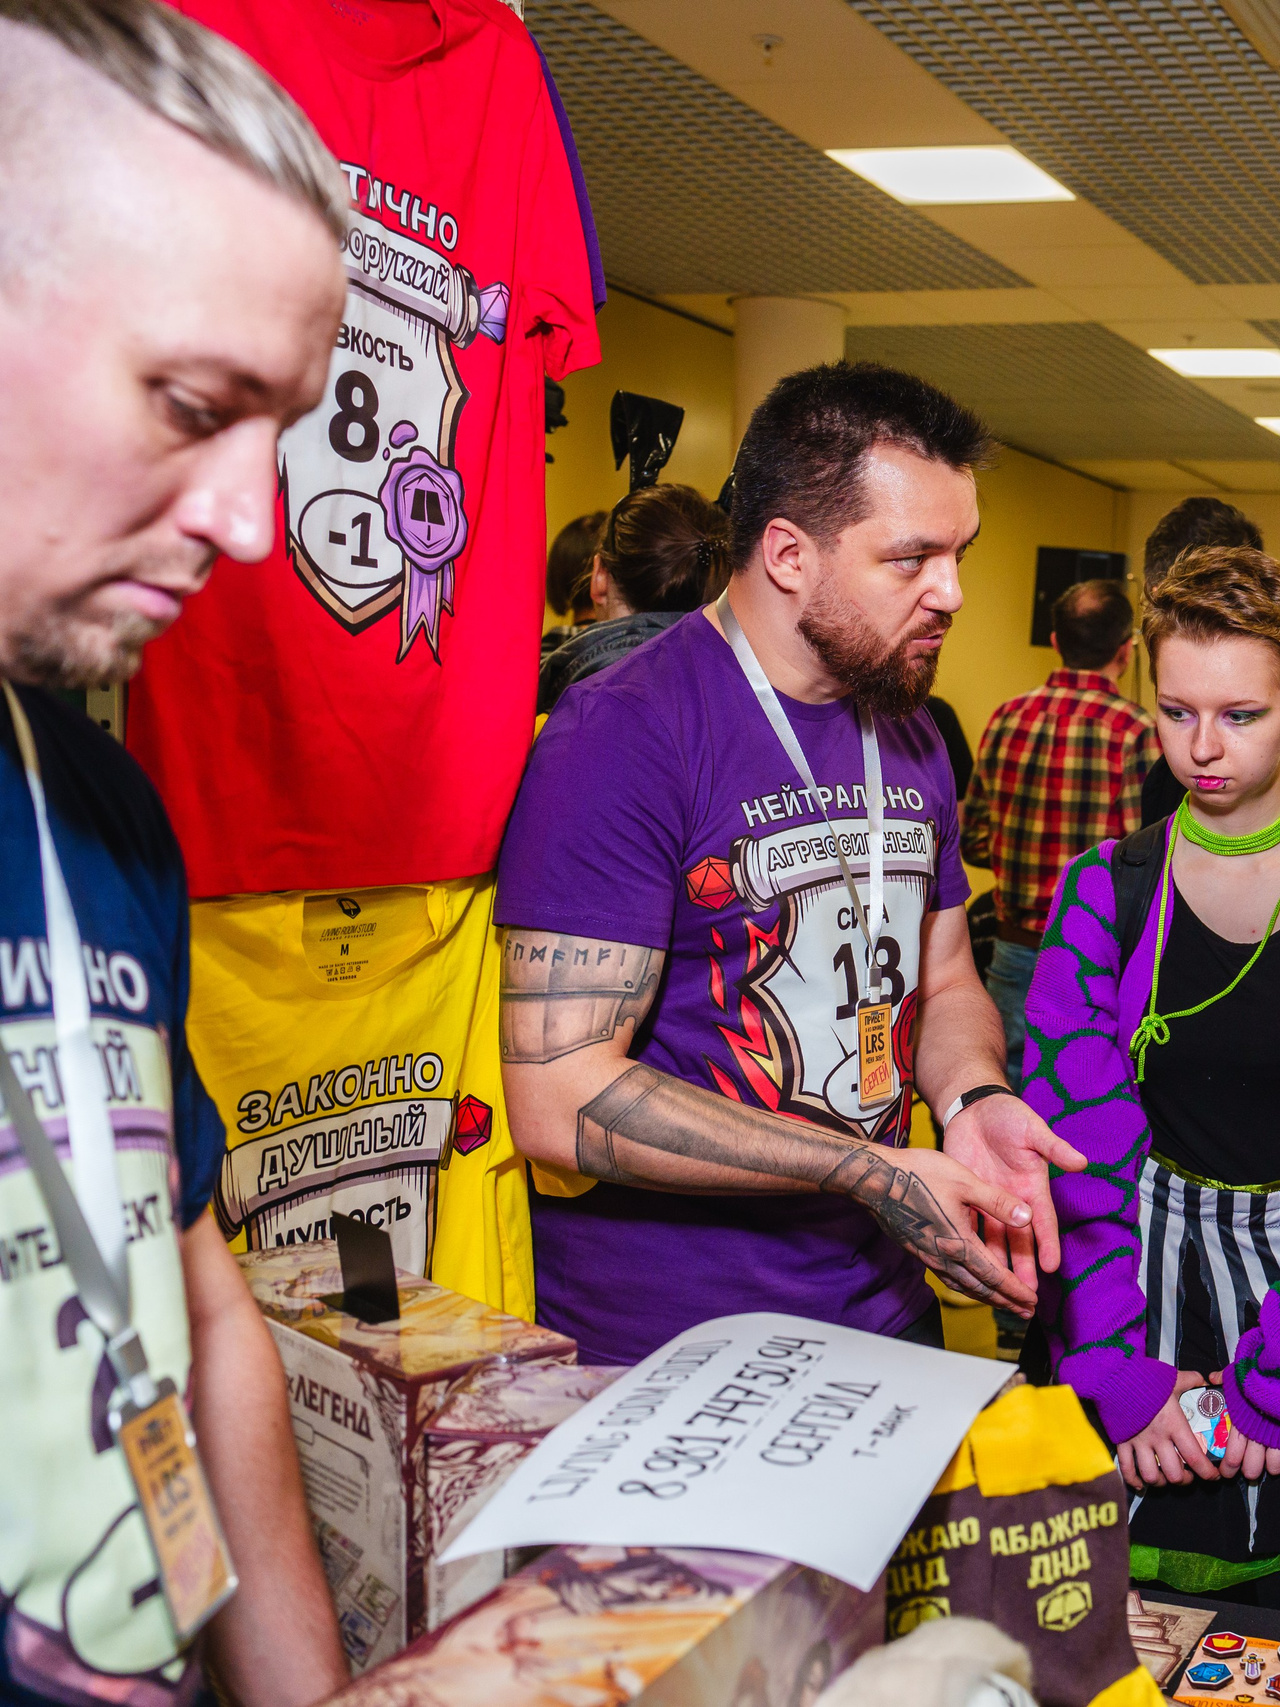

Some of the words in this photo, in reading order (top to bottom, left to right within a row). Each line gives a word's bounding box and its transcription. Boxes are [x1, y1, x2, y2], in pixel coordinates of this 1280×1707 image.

[340, 161, 459, 252] ТИЧНО
[334, 322, 414, 372] ВКОСТЬ
[328, 370, 381, 463] 8
[329, 511, 378, 569] -1
[741, 784, 924, 827] НЕЙТРАЛНО
[768, 828, 927, 871] АГРЕССИНЫЙ
[340, 943, 350, 956] M
[832, 935, 905, 1021] 18
[865, 1032, 884, 1055] LRS
[238, 1052, 444, 1132] ЗАКОННО
[863, 1060, 890, 1095] СЕРГЕЙ
[258, 1105, 428, 1194] ДУШНЫЙ
[275, 1195, 412, 1247] МУДОСТЬ
[734, 1360, 797, 1388] 50
[757, 1337, 827, 1363] 94
[294, 1373, 374, 1442] ЛЕГЕНД
[684, 1384, 773, 1428] 747
[644, 1434, 732, 1479] 981
[618, 1480, 687, 1500] 8
[989, 1501, 1119, 1556] АБАЖАЮ
[1027, 1537, 1091, 1589] ДНД
